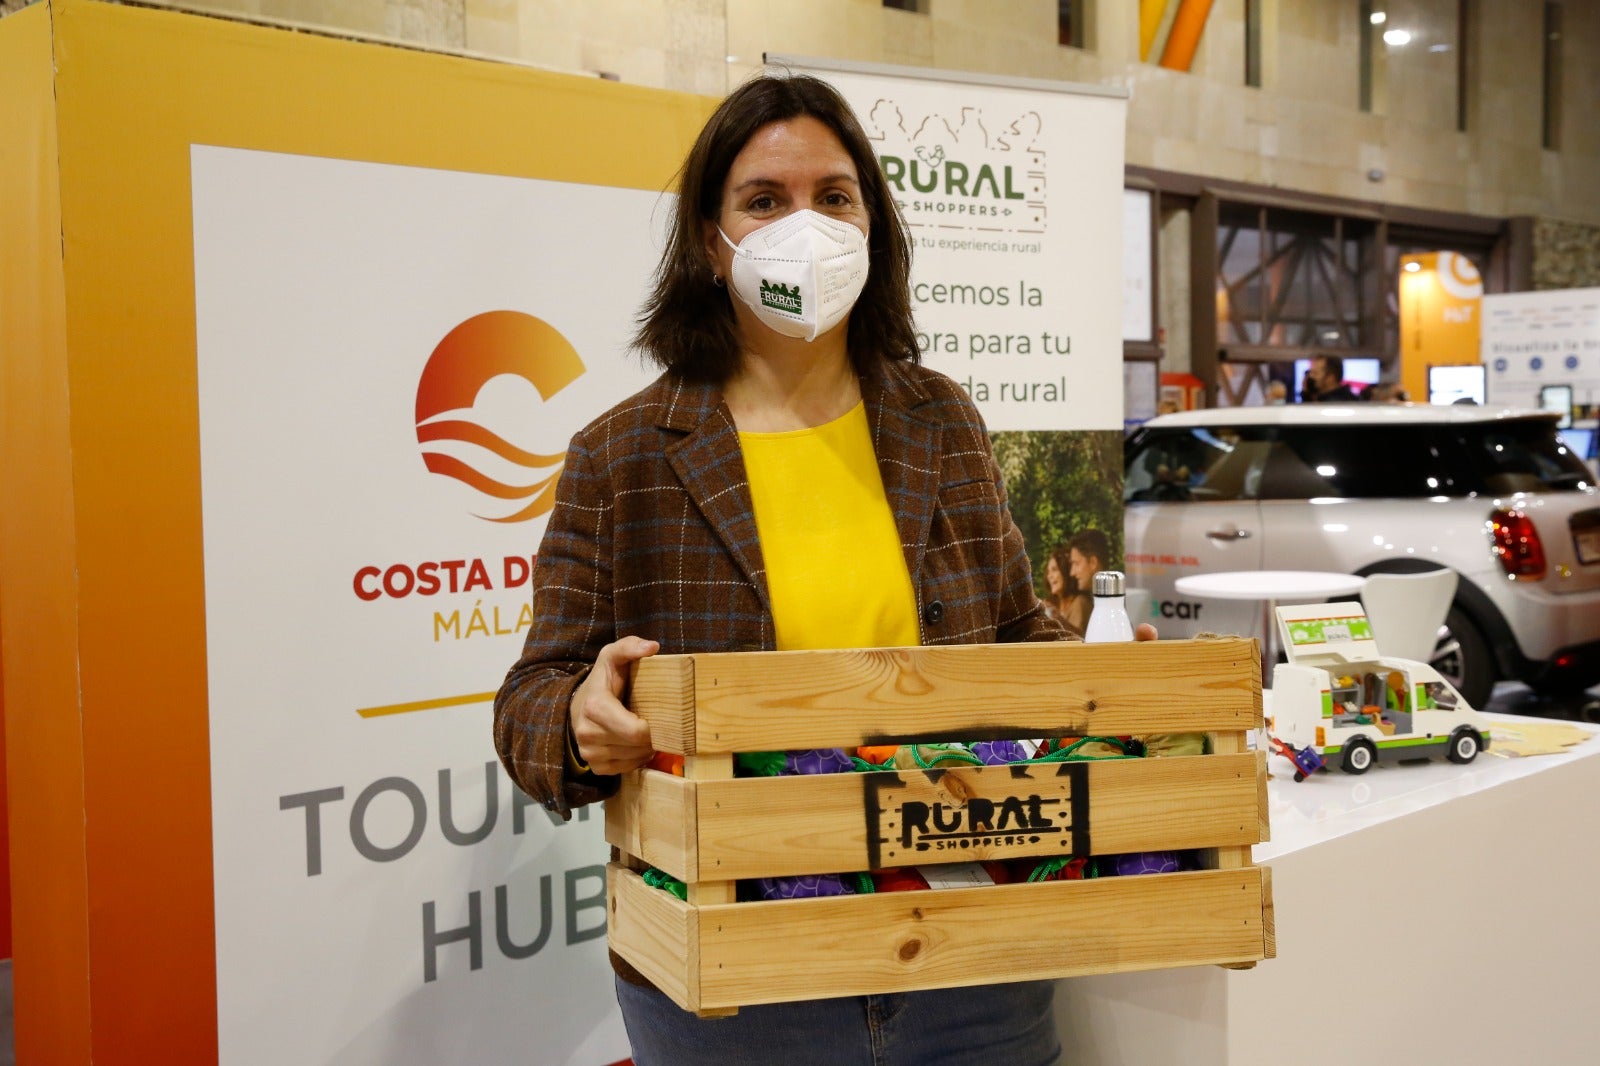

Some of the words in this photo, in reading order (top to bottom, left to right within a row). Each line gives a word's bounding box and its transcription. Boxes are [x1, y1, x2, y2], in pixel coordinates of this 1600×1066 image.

[879, 155, 1025, 200] RURAL
[912, 201, 998, 217] SHOPPERS
[921, 236, 936, 248] tu
[938, 236, 1009, 253] experiencia
[1011, 241, 1042, 254] rural
[764, 291, 798, 307] RURAL
[1019, 280, 1043, 308] la
[968, 332, 1031, 360] para
[1041, 331, 1072, 355] tu
[1000, 376, 1067, 403] rural
[352, 559, 493, 602] COSTA
[503, 554, 538, 588] D
[902, 794, 1053, 849] RURAL
[936, 835, 1025, 850] SHOPPERS
[422, 863, 609, 983] HUB
